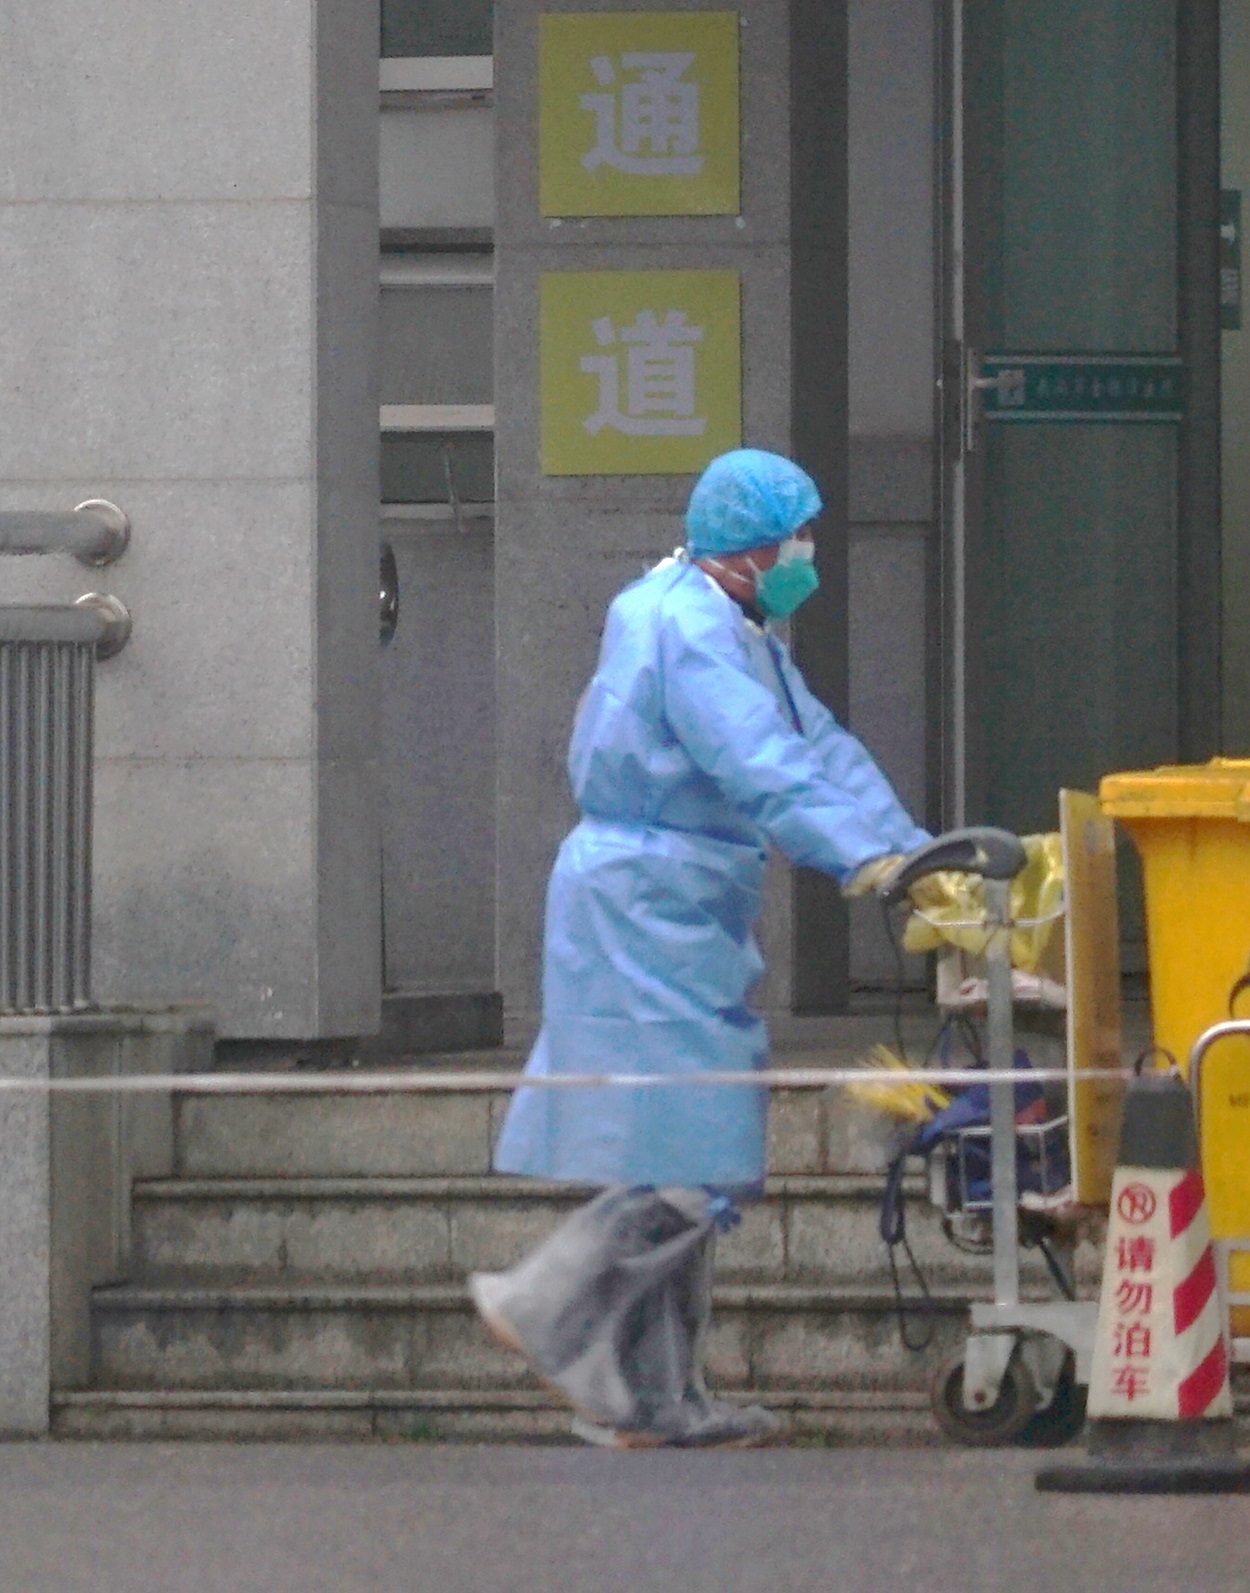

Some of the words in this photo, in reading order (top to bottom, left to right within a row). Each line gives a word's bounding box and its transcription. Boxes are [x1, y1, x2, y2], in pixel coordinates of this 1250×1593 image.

[579, 51, 707, 437] 通道
[1110, 1234, 1155, 1402] 请勿泊车
